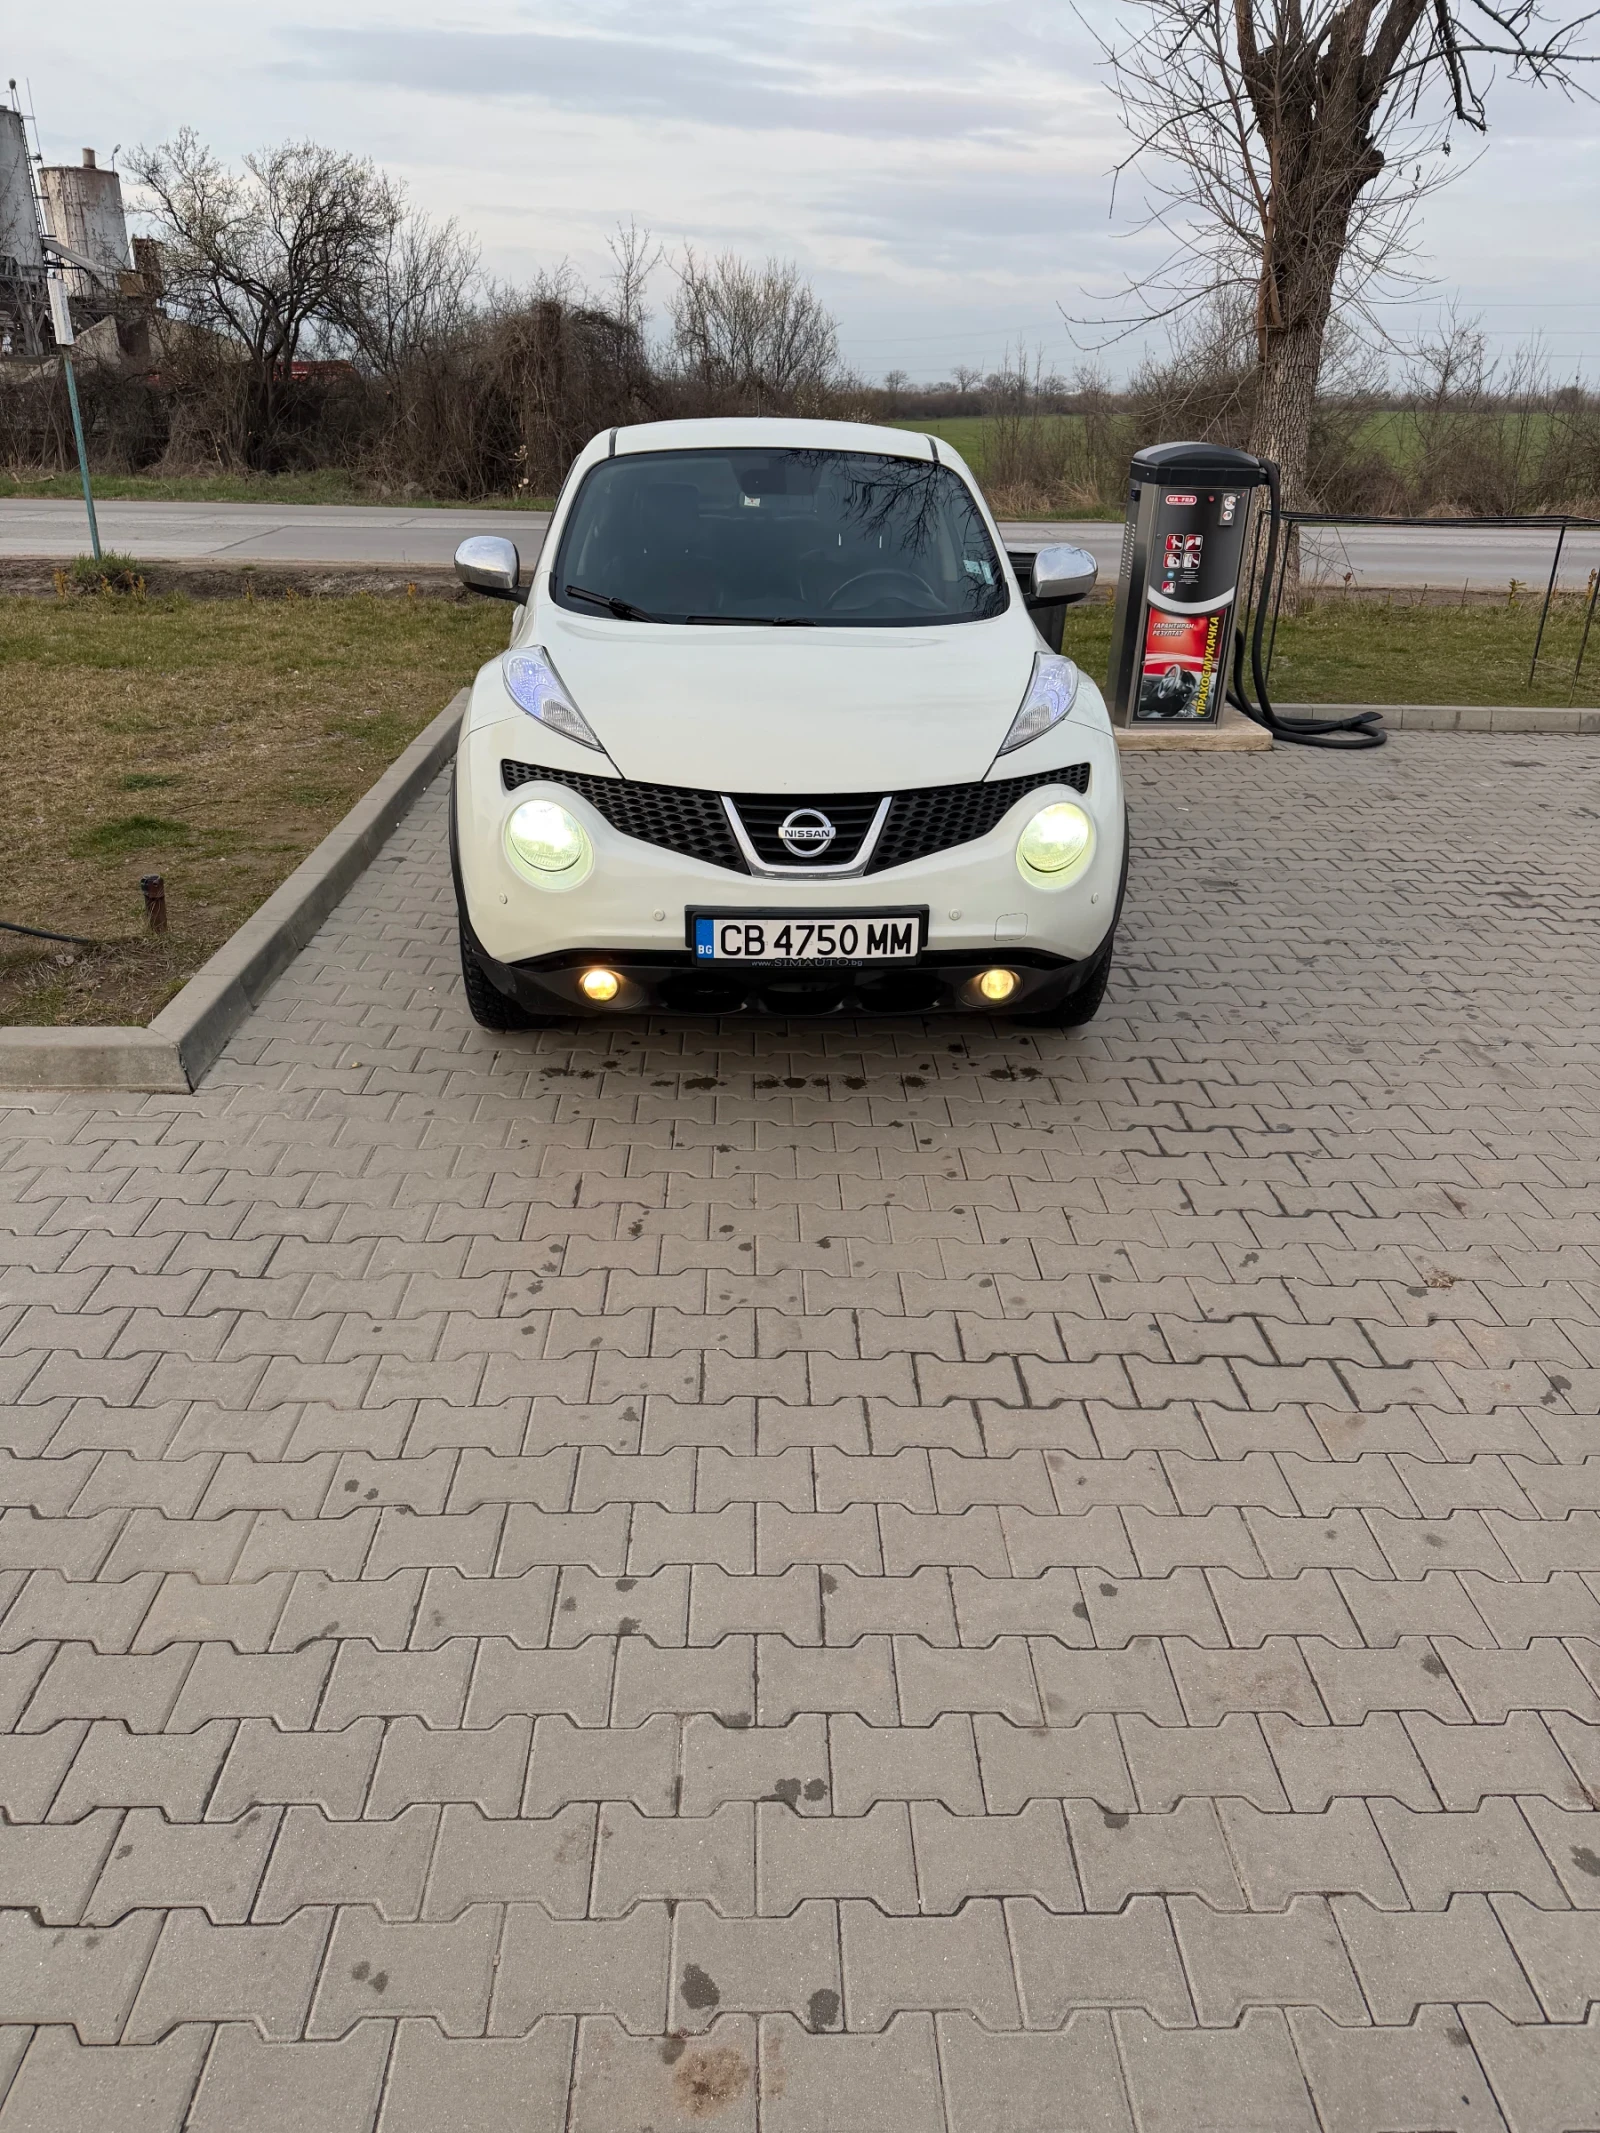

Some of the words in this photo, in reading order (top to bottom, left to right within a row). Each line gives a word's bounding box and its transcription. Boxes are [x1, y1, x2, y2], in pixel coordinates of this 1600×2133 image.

[1196, 616, 1220, 715] ПРАХОСМУКАЧКА
[698, 945, 713, 954] BG
[773, 924, 859, 956] 4750
[866, 923, 912, 955] MM
